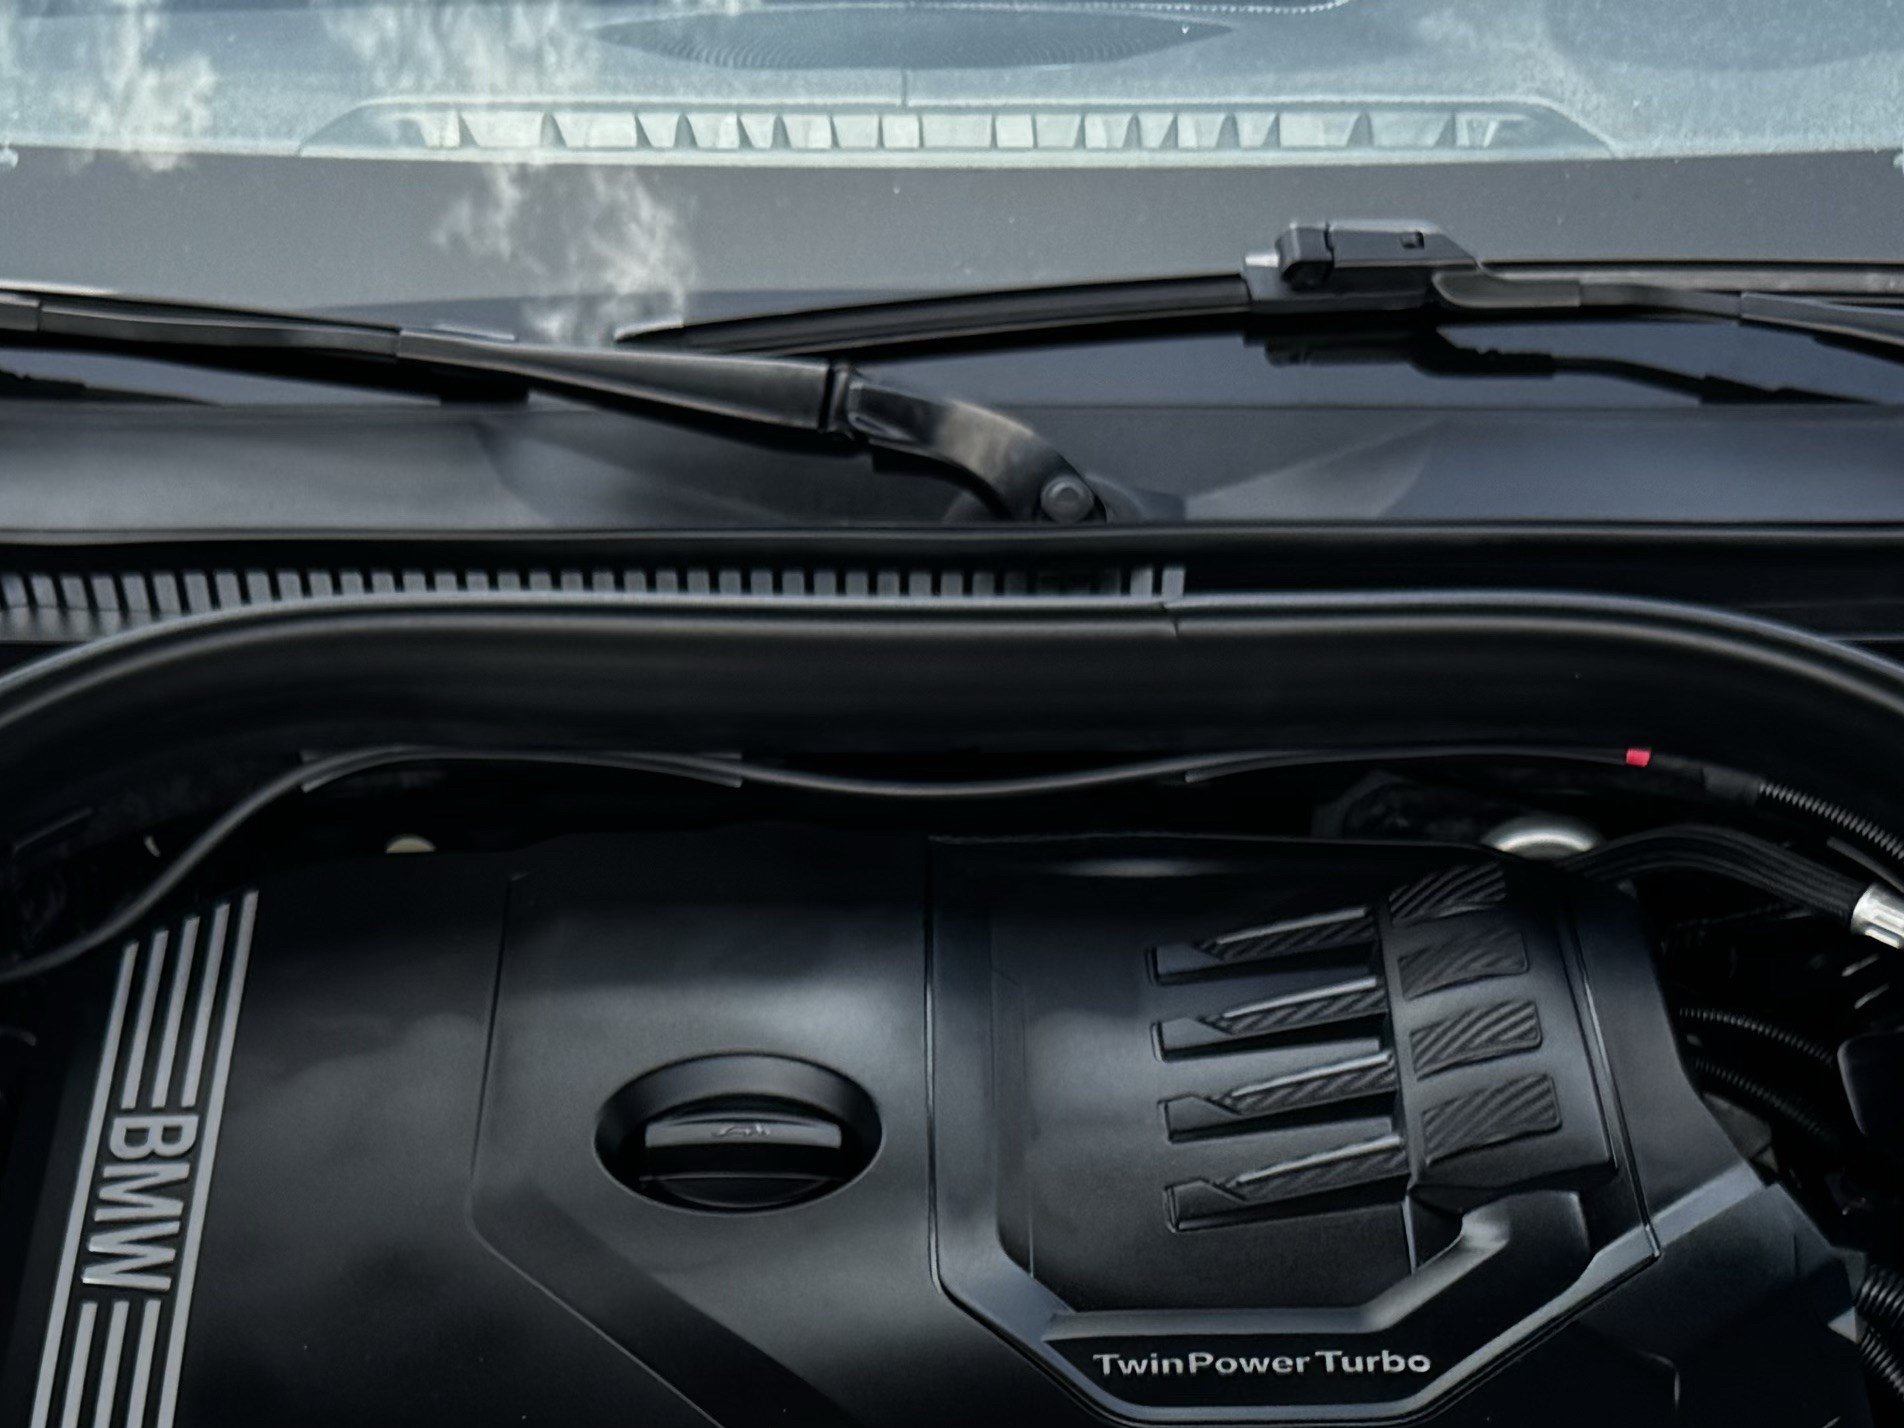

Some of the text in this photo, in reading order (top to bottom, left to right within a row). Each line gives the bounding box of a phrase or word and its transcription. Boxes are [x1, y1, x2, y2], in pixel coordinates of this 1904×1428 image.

[82, 1115, 199, 1291] BMW
[1092, 1350, 1432, 1376] TwinPower Turbo
